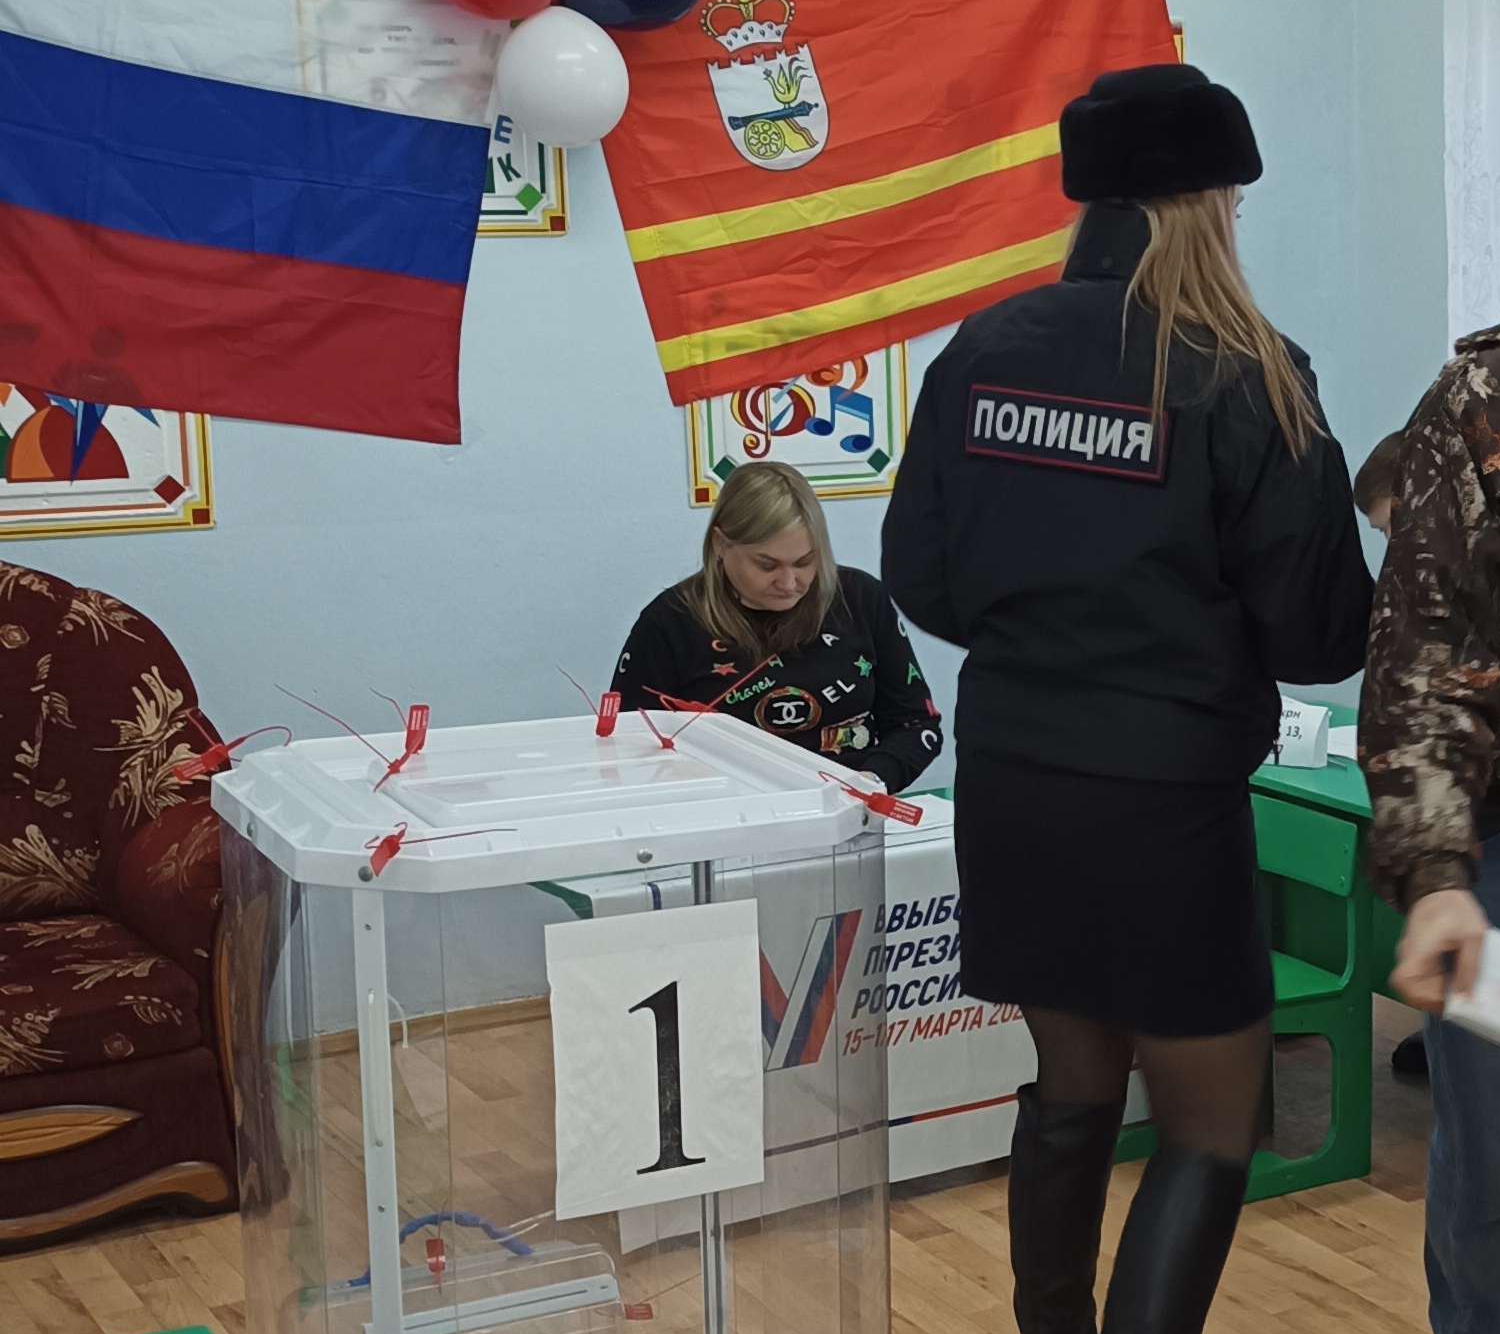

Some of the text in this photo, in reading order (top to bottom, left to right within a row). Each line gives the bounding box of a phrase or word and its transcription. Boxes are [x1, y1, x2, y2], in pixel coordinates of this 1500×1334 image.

[974, 399, 1153, 462] ПОЛИЦИЯ
[909, 1004, 984, 1043] МАРТА
[628, 980, 706, 1175] 1
